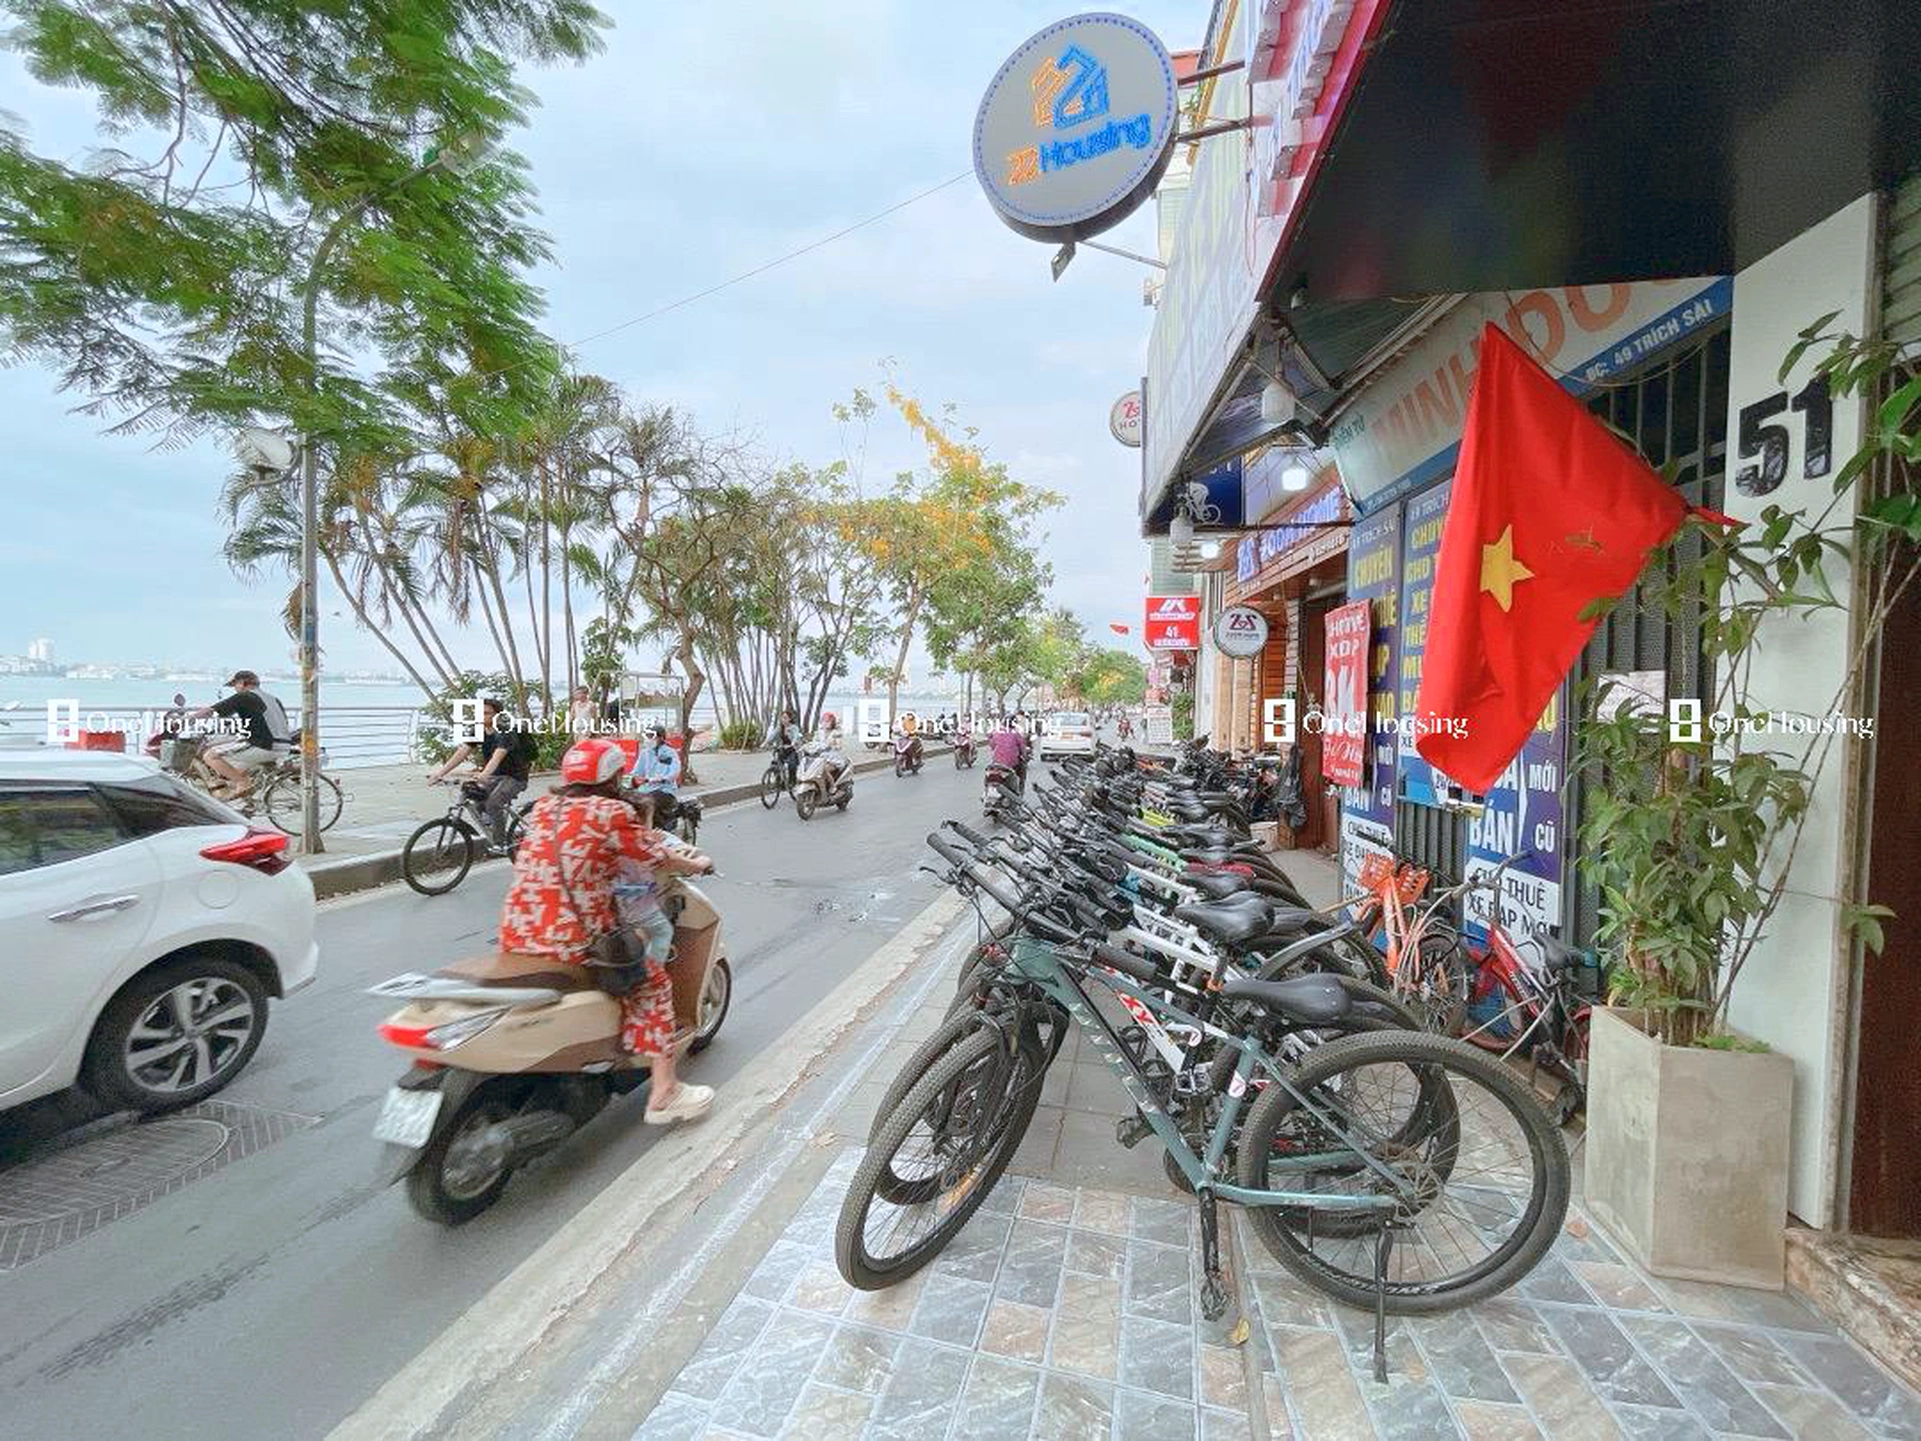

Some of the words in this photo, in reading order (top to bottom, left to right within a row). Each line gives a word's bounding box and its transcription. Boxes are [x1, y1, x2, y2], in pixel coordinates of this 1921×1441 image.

[1735, 369, 1833, 498] 51
[1528, 759, 1558, 793] MỚI
[1534, 820, 1556, 853] CŨ
[1507, 876, 1546, 912] THUÊ
